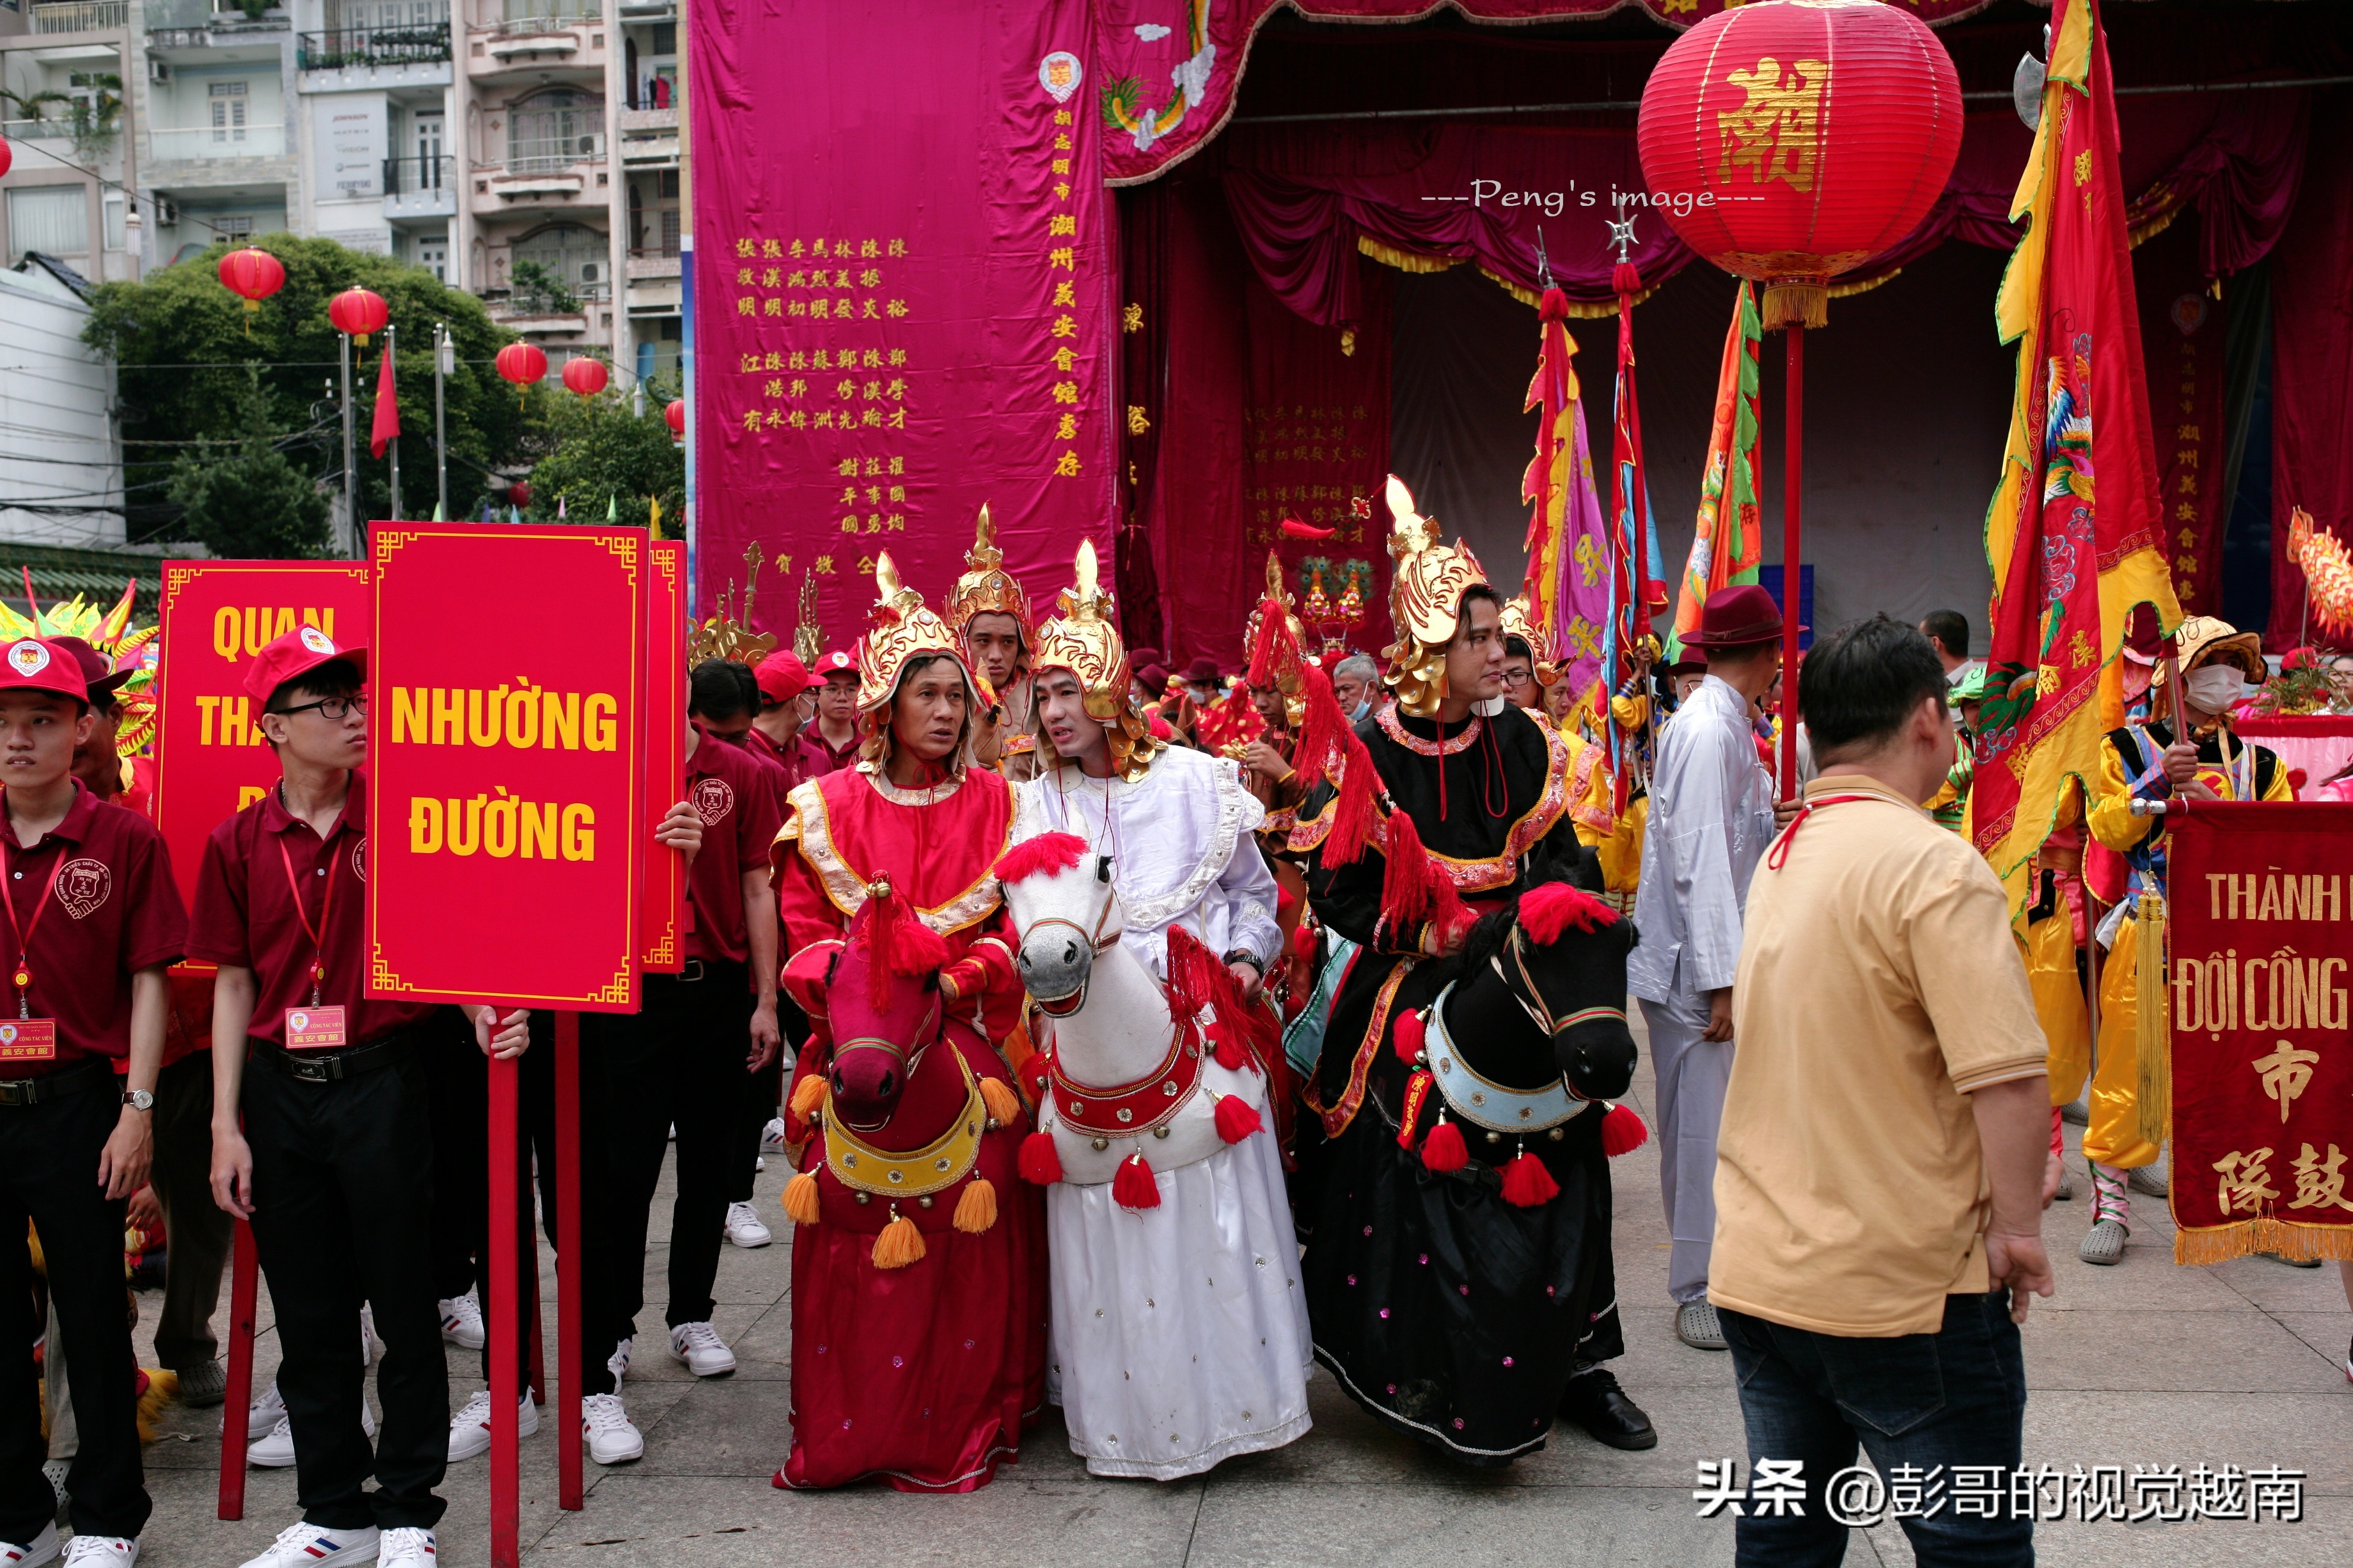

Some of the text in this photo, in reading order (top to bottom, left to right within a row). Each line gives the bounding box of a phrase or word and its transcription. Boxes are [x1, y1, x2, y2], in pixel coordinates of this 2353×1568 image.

[391, 676, 618, 752] NHƯỜNG
[408, 786, 595, 862] ĐƯỜNG
[2206, 866, 2340, 921] THÀNH
[2171, 944, 2348, 1042] ĐỘI CỒNG
[2252, 1039, 2319, 1124] 市
